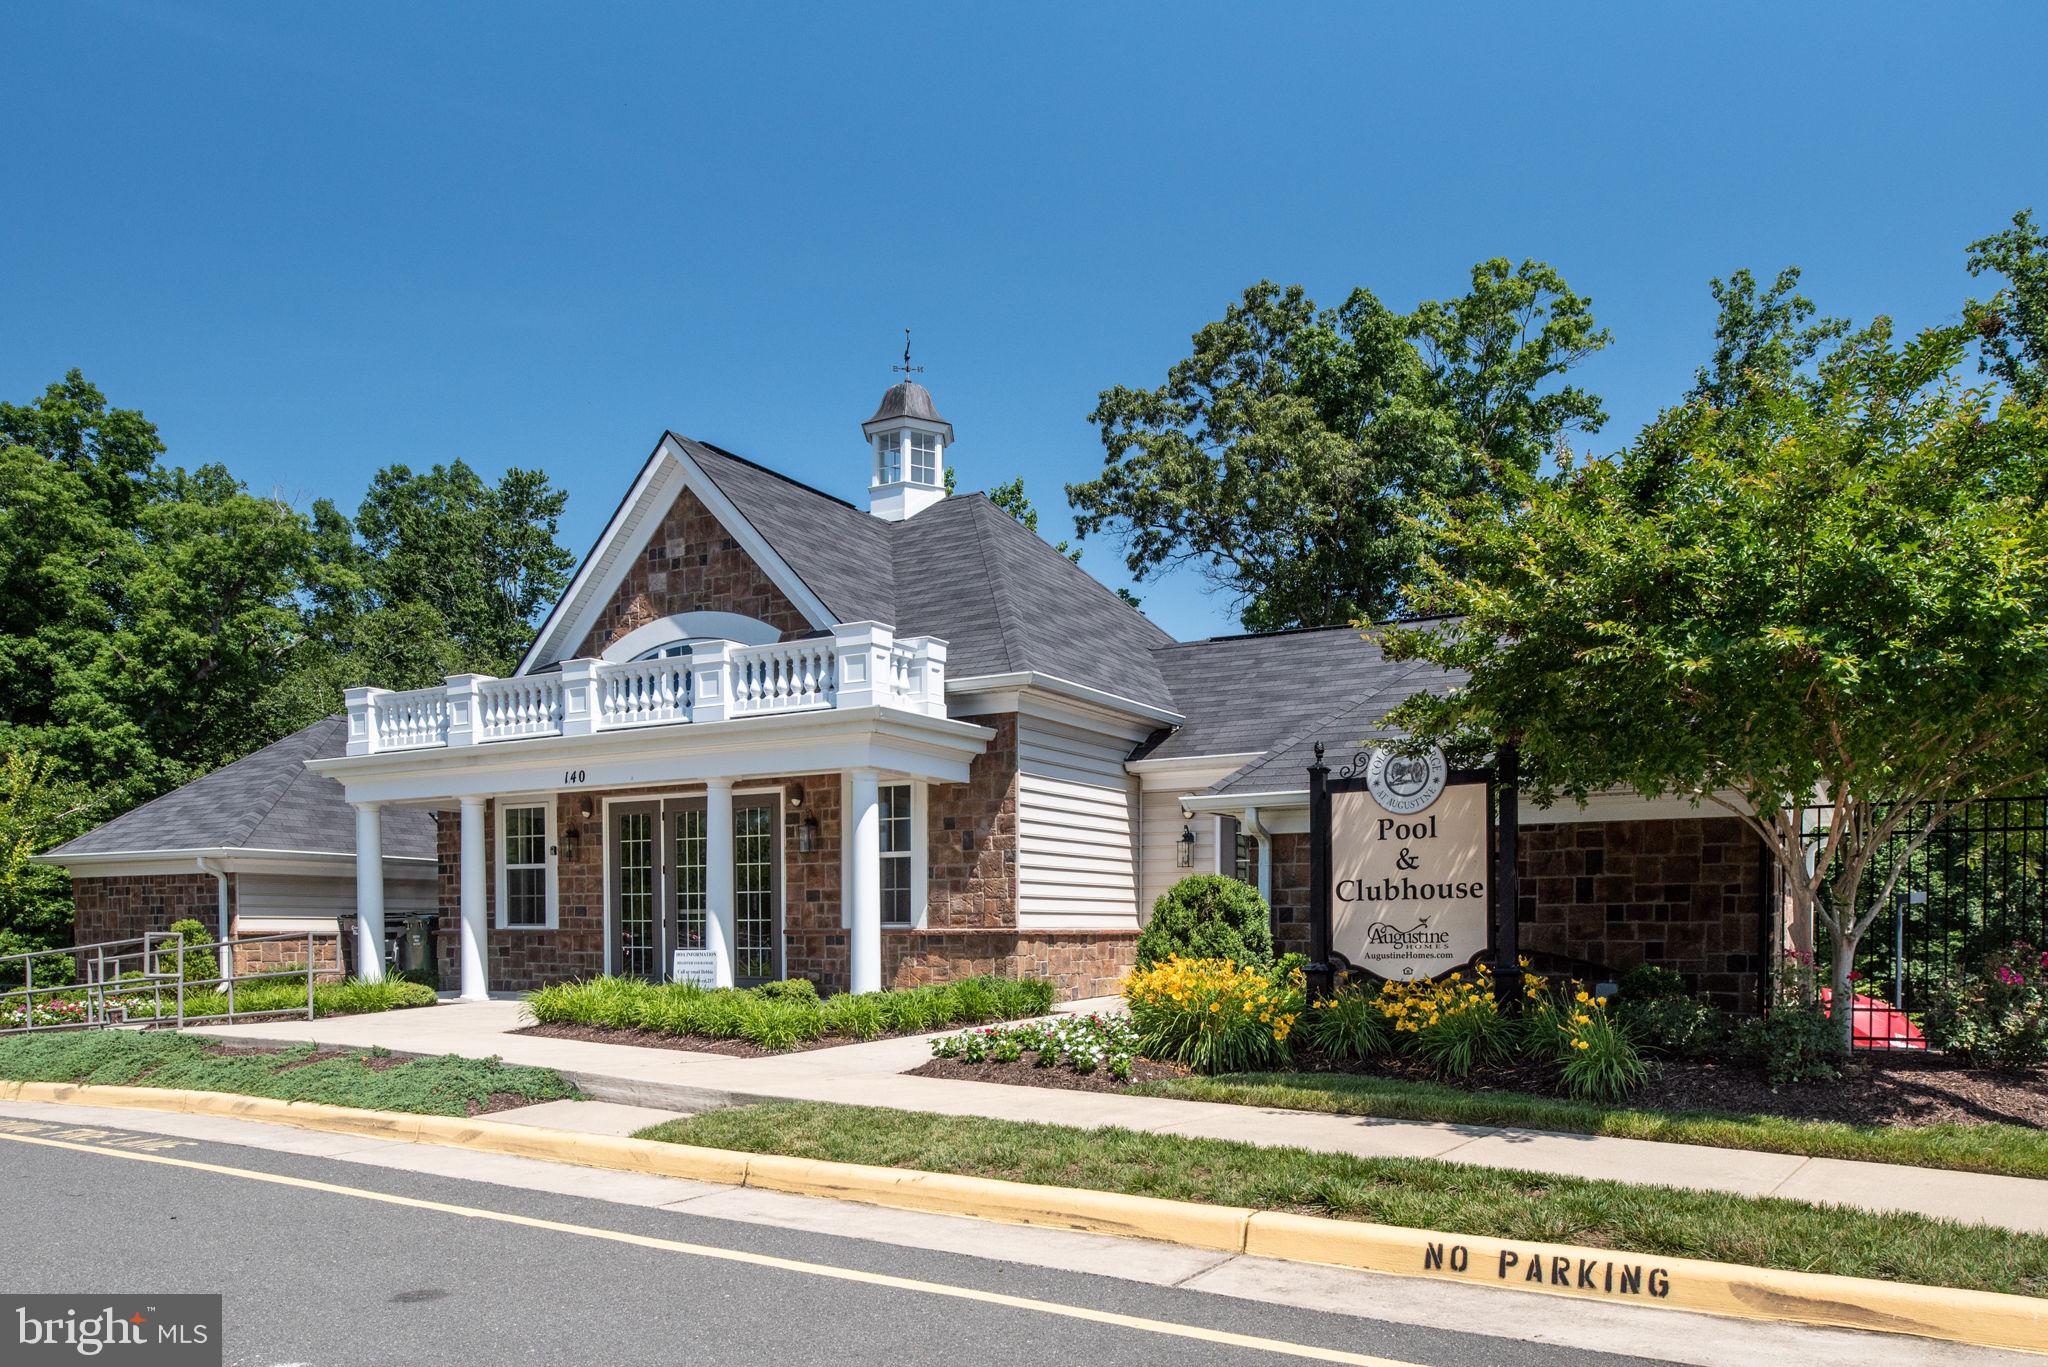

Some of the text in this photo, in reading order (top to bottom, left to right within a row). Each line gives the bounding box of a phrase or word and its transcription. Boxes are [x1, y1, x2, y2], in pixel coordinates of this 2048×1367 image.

[564, 769, 586, 784] 140
[1376, 787, 1437, 809] AT AUGUSTINE
[1377, 815, 1438, 841] Pool
[1396, 847, 1420, 870] &
[1335, 877, 1484, 902] Clubhouse
[1367, 922, 1450, 950] Augustine
[1364, 952, 1454, 961] AugustineHomes.com
[1424, 1242, 1670, 1298] NO PARKING
